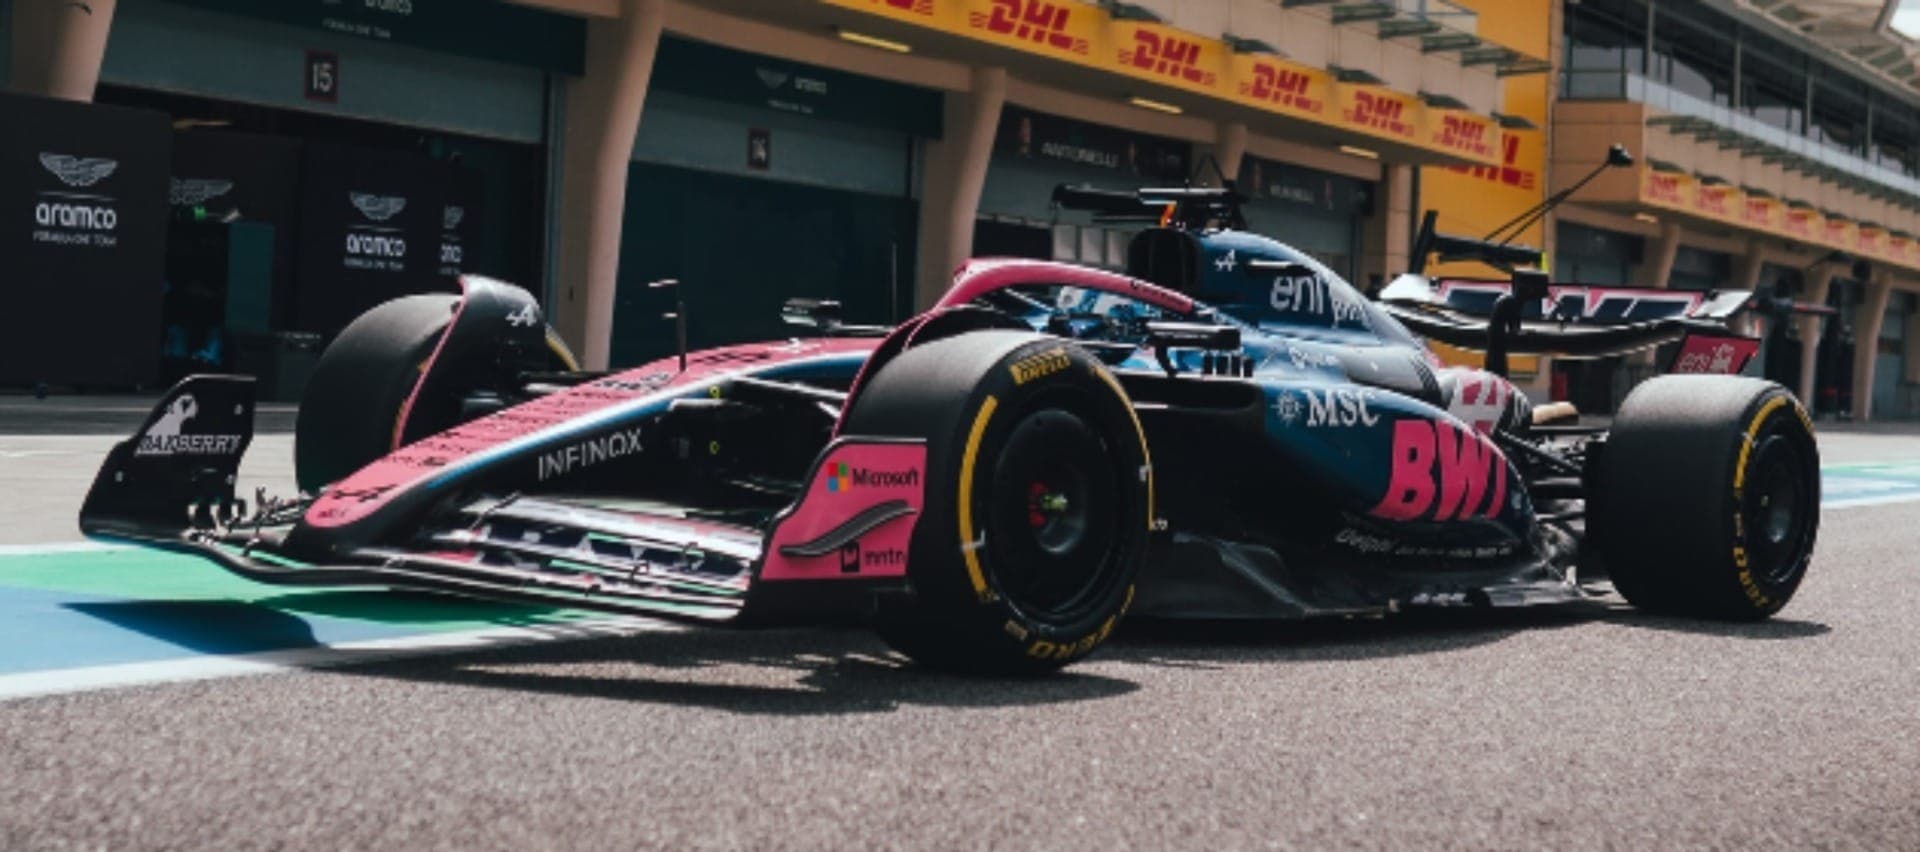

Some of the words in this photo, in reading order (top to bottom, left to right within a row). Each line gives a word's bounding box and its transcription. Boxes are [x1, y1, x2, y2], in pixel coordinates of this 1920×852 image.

[986, 0, 1077, 50] DHL
[312, 62, 334, 92] 15
[1132, 30, 1203, 84] DHL
[1251, 63, 1314, 111] DHL
[1352, 91, 1408, 134] DHL
[1440, 115, 1489, 155] DHL
[36, 202, 117, 230] aramco
[346, 233, 406, 257] aramco
[1307, 389, 1381, 428] MSC
[538, 427, 643, 481] INFINOX
[853, 467, 919, 486] Microsoft
